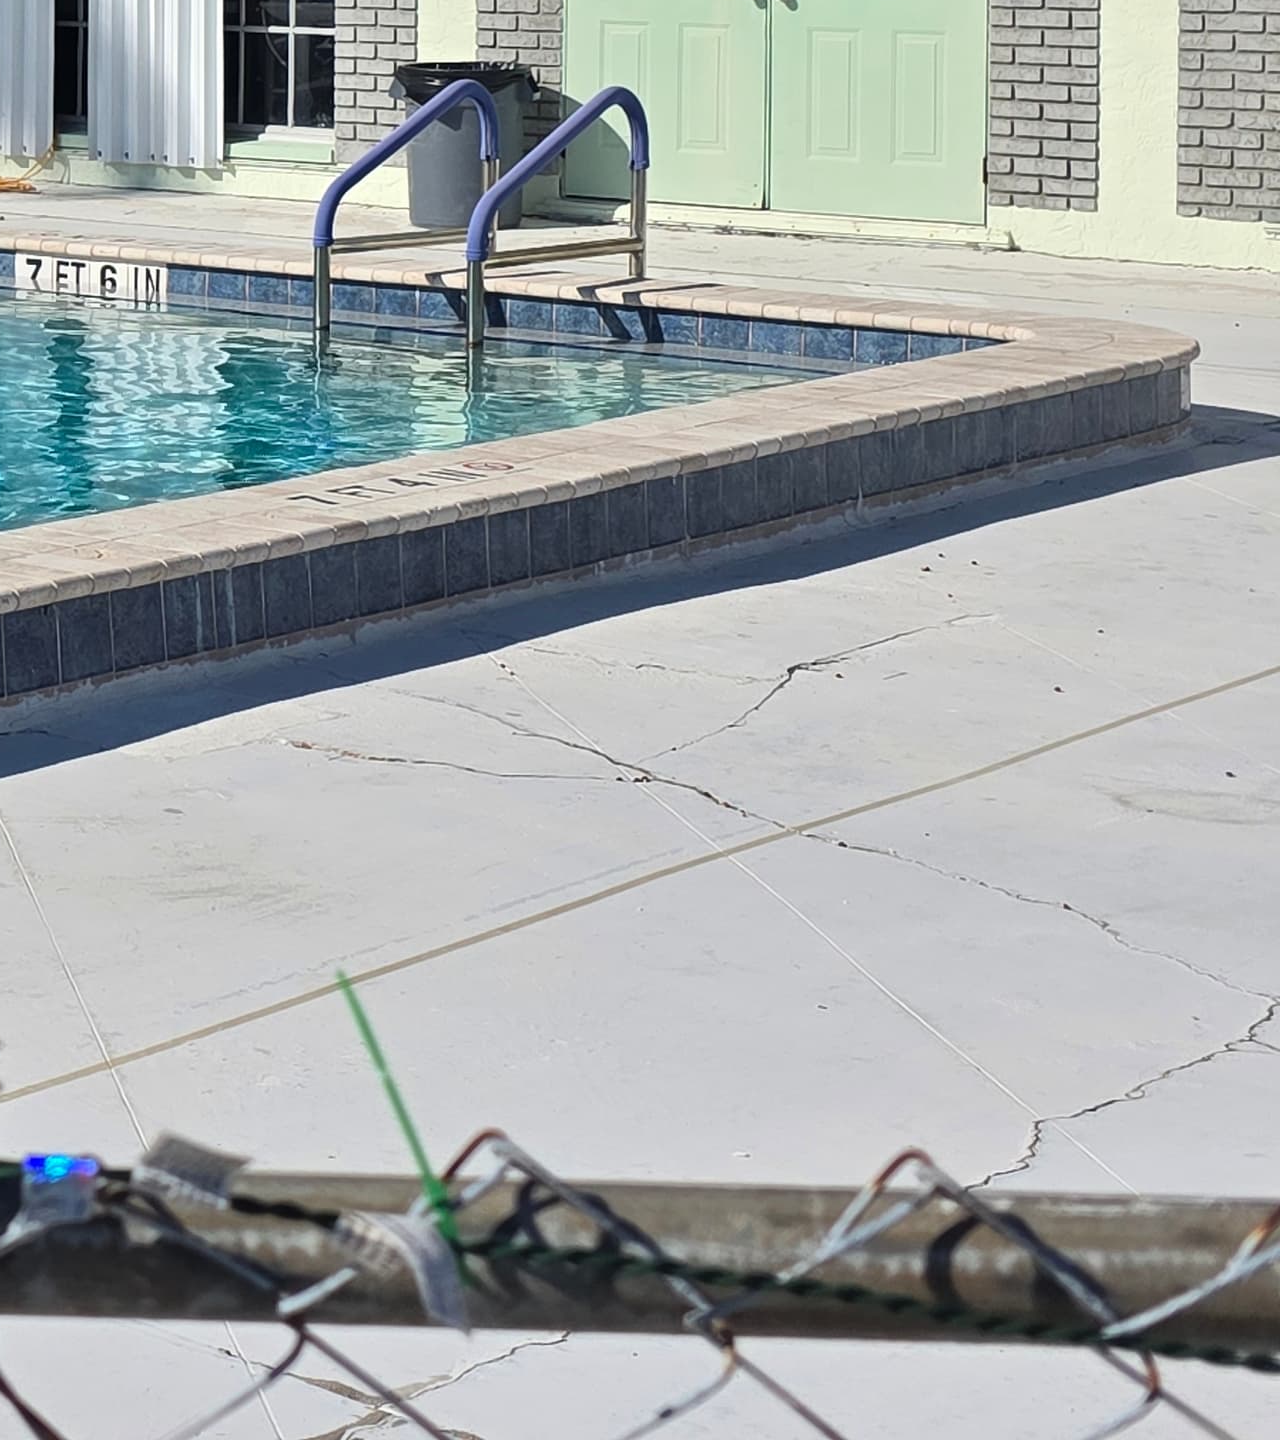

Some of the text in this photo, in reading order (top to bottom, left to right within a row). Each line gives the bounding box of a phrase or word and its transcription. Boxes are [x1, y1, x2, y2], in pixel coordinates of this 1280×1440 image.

[26, 258, 42, 291] 7
[100, 265, 117, 300] 6
[134, 266, 160, 306] IN
[287, 494, 340, 505] 7
